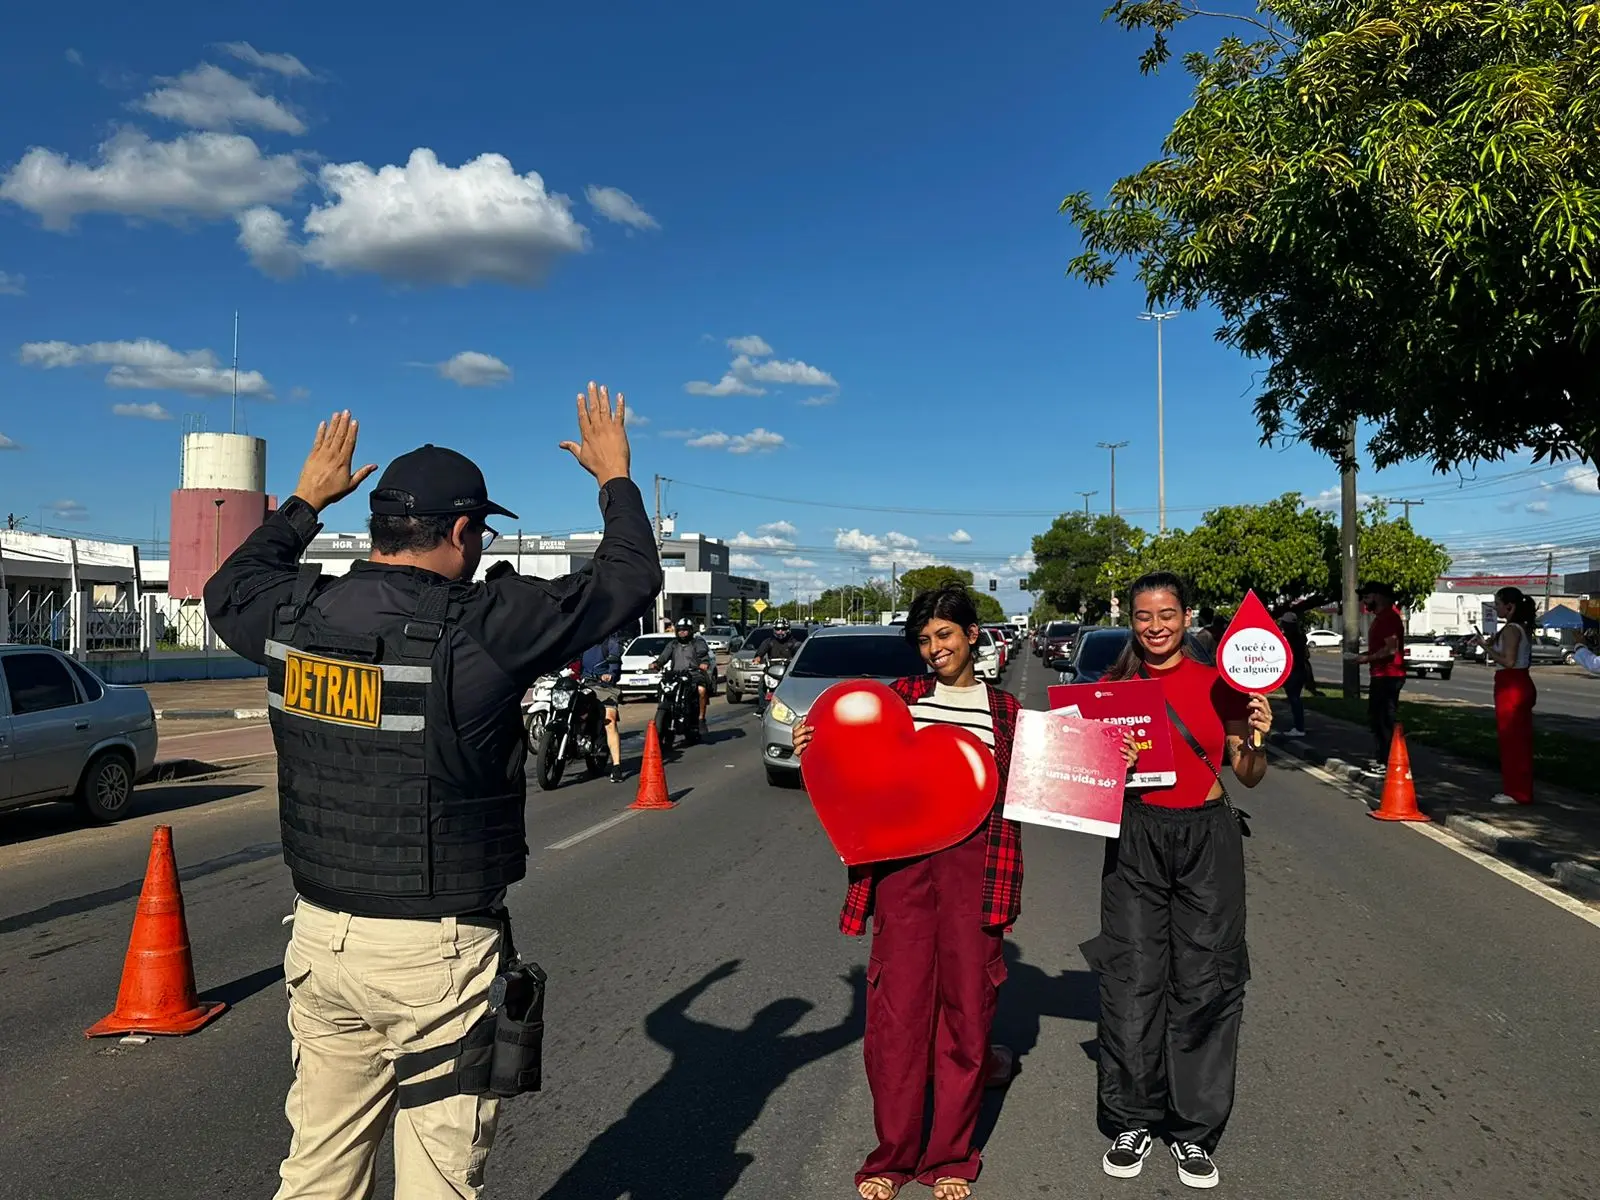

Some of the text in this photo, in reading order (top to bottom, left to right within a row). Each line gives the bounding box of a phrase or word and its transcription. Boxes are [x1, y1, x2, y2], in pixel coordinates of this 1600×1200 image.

[332, 541, 372, 549] HGR Ho
[1234, 643, 1259, 652] Você
[1260, 643, 1267, 652] é
[1244, 654, 1264, 665] tipo
[1228, 664, 1282, 675] de alguém.
[286, 656, 377, 722] DETRAN
[1103, 715, 1152, 726] sangue
[1045, 770, 1071, 781] uma
[1072, 773, 1096, 785] vida
[1097, 778, 1118, 789] só?
